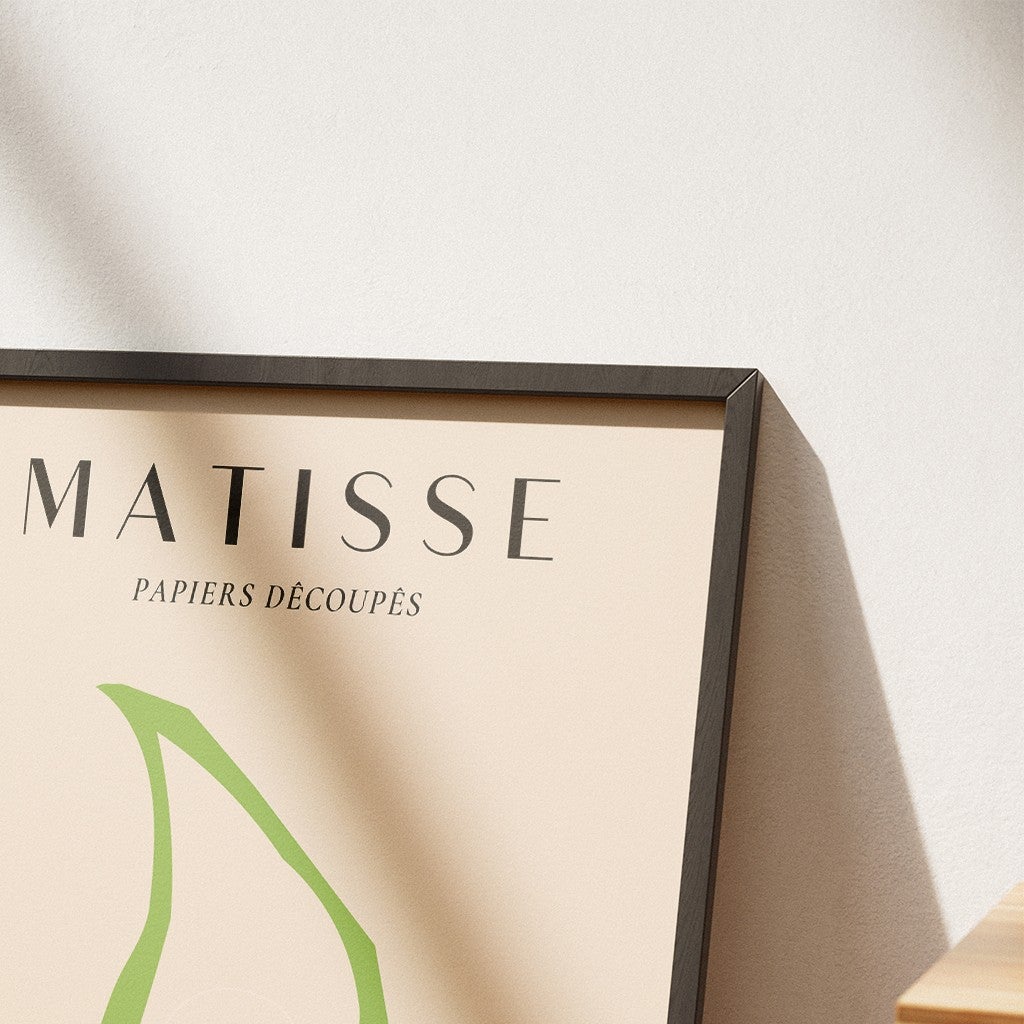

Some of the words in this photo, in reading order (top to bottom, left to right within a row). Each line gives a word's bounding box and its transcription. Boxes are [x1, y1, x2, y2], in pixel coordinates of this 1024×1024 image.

[23, 457, 561, 561] MATISSE
[132, 578, 255, 608] PAPIERS
[264, 581, 422, 617] DÊCOUPÊS
